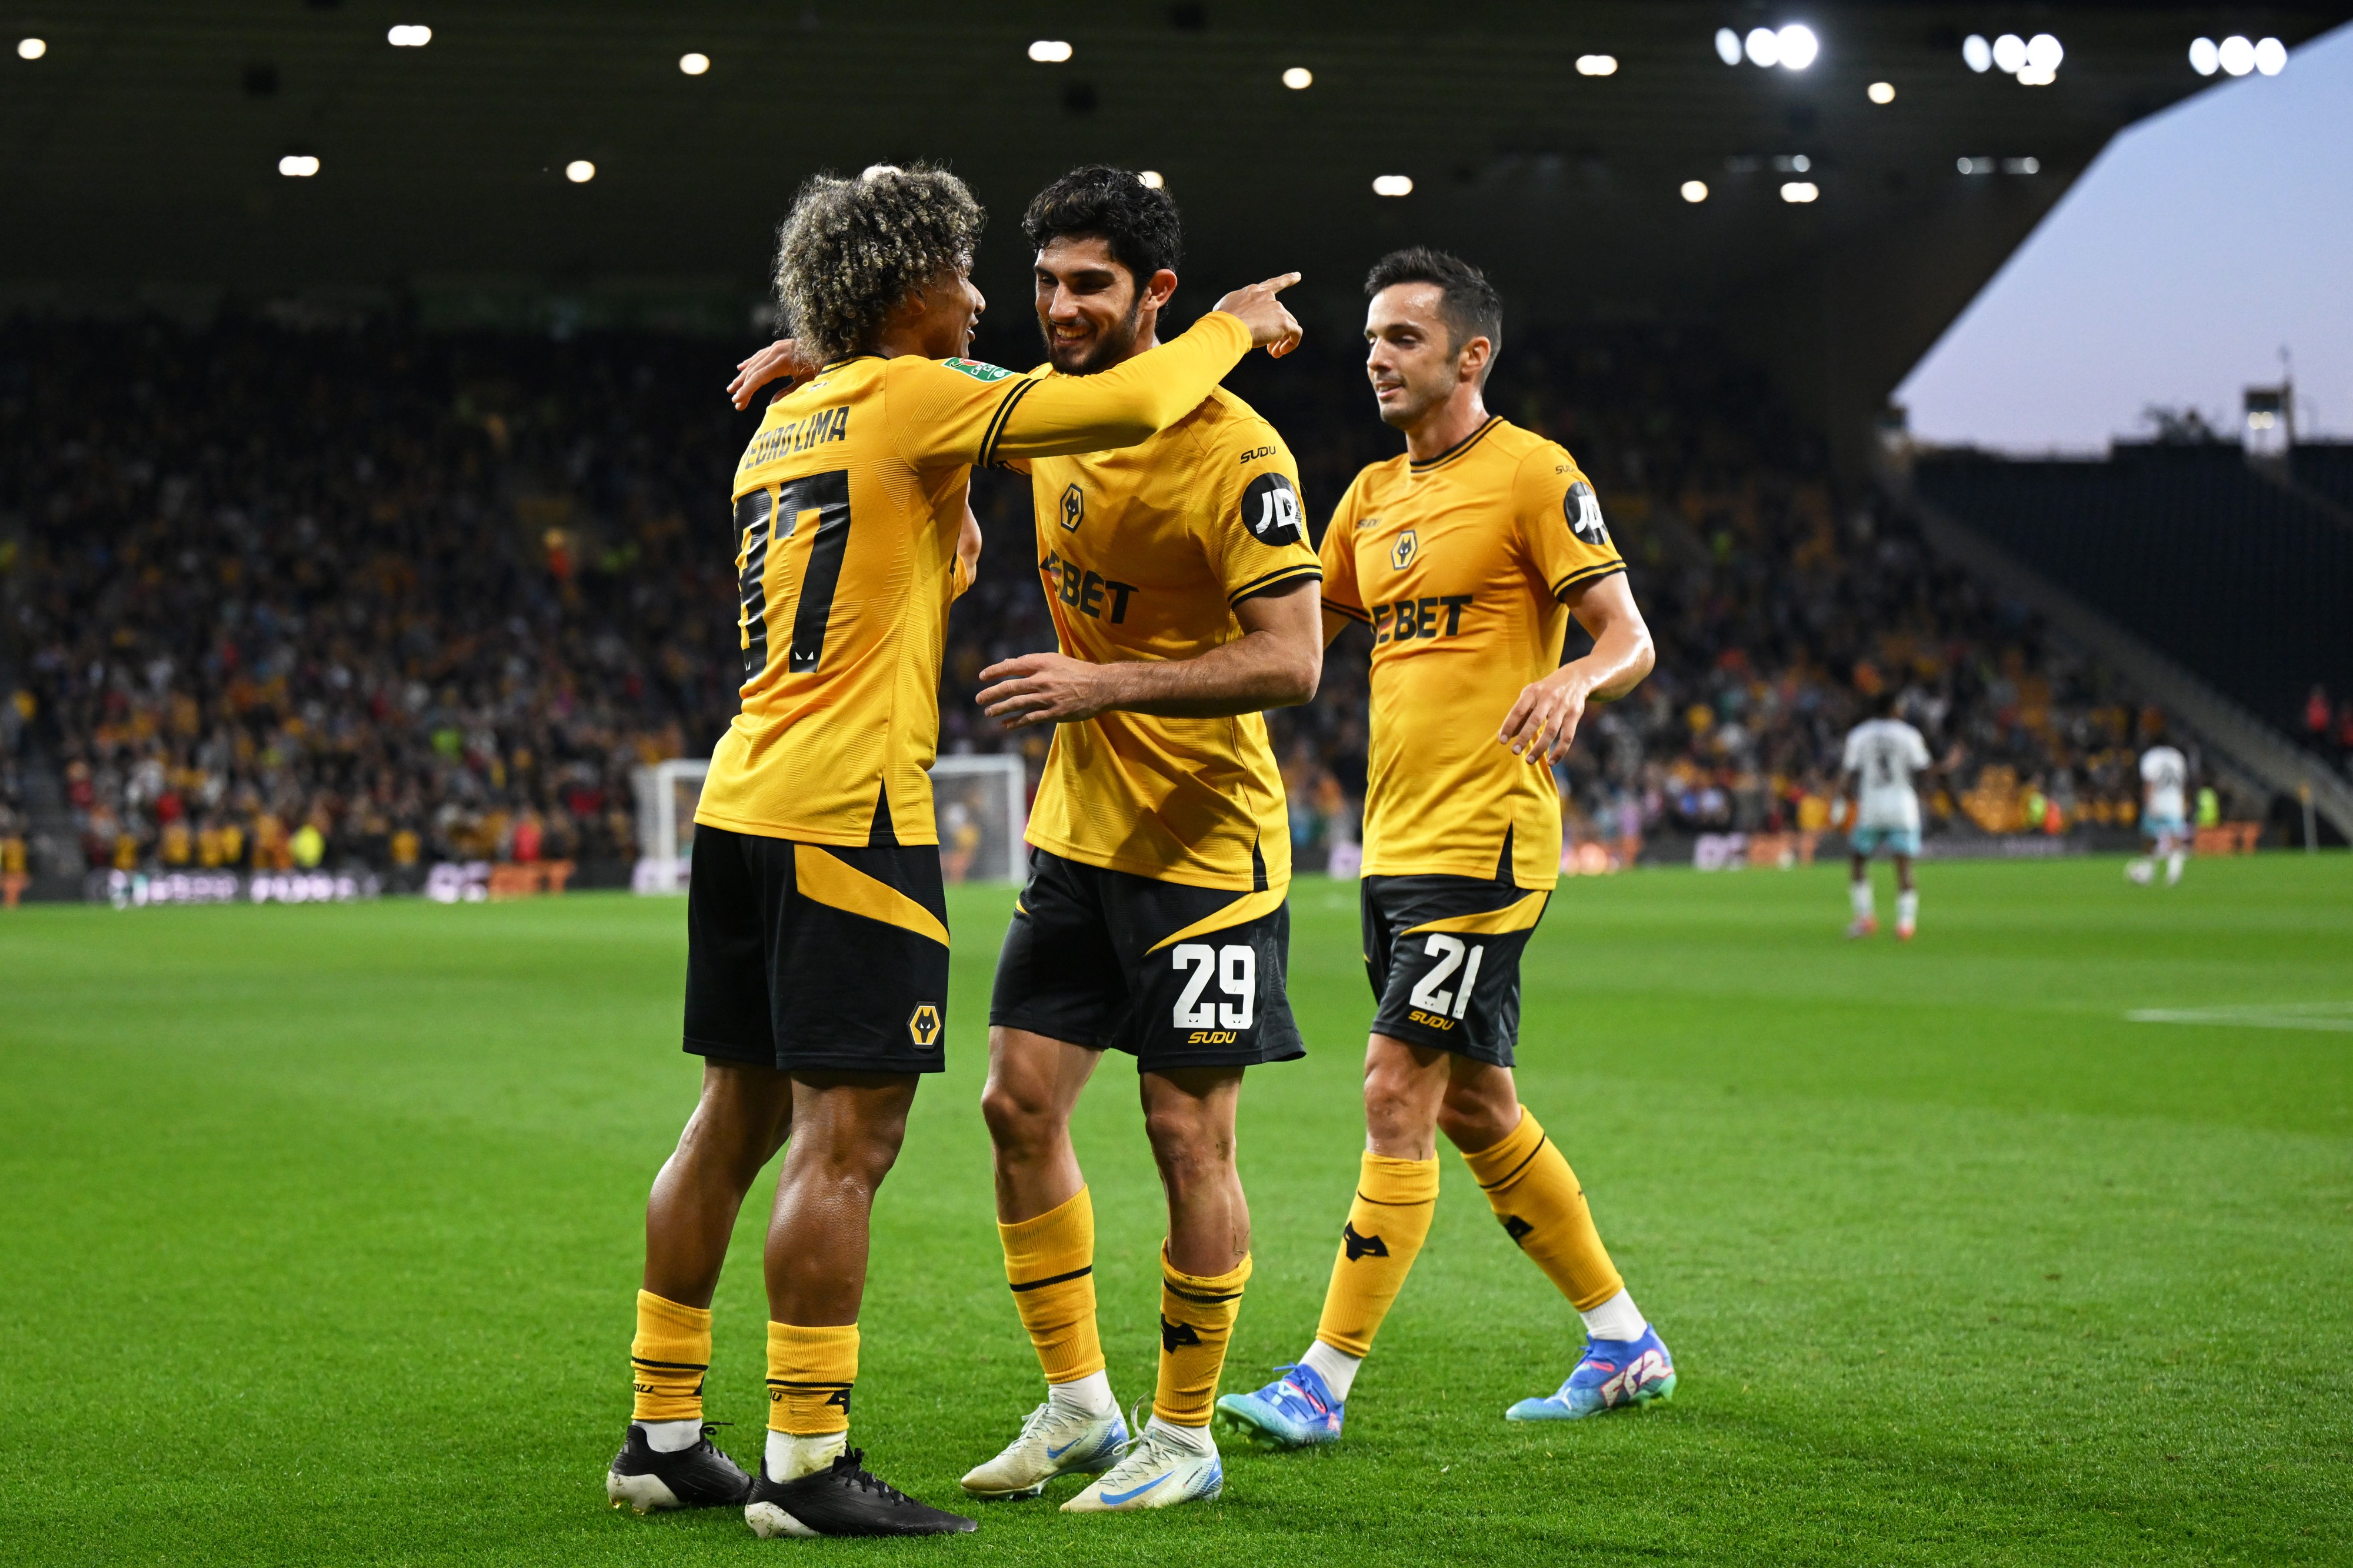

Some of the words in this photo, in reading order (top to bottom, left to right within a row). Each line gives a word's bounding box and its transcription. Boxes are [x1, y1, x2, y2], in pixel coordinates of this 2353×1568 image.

[744, 423, 796, 469] EDRO
[794, 406, 849, 452] LIMA
[1240, 446, 1276, 464] SUDU
[1256, 488, 1296, 534] JD
[1575, 494, 1604, 533] JD
[1371, 595, 1473, 643] EBET
[1173, 944, 1256, 1029] 29
[1409, 933, 1484, 1020] 21
[1188, 1032, 1237, 1043] SUDU
[1408, 1010, 1455, 1030] SUDU
